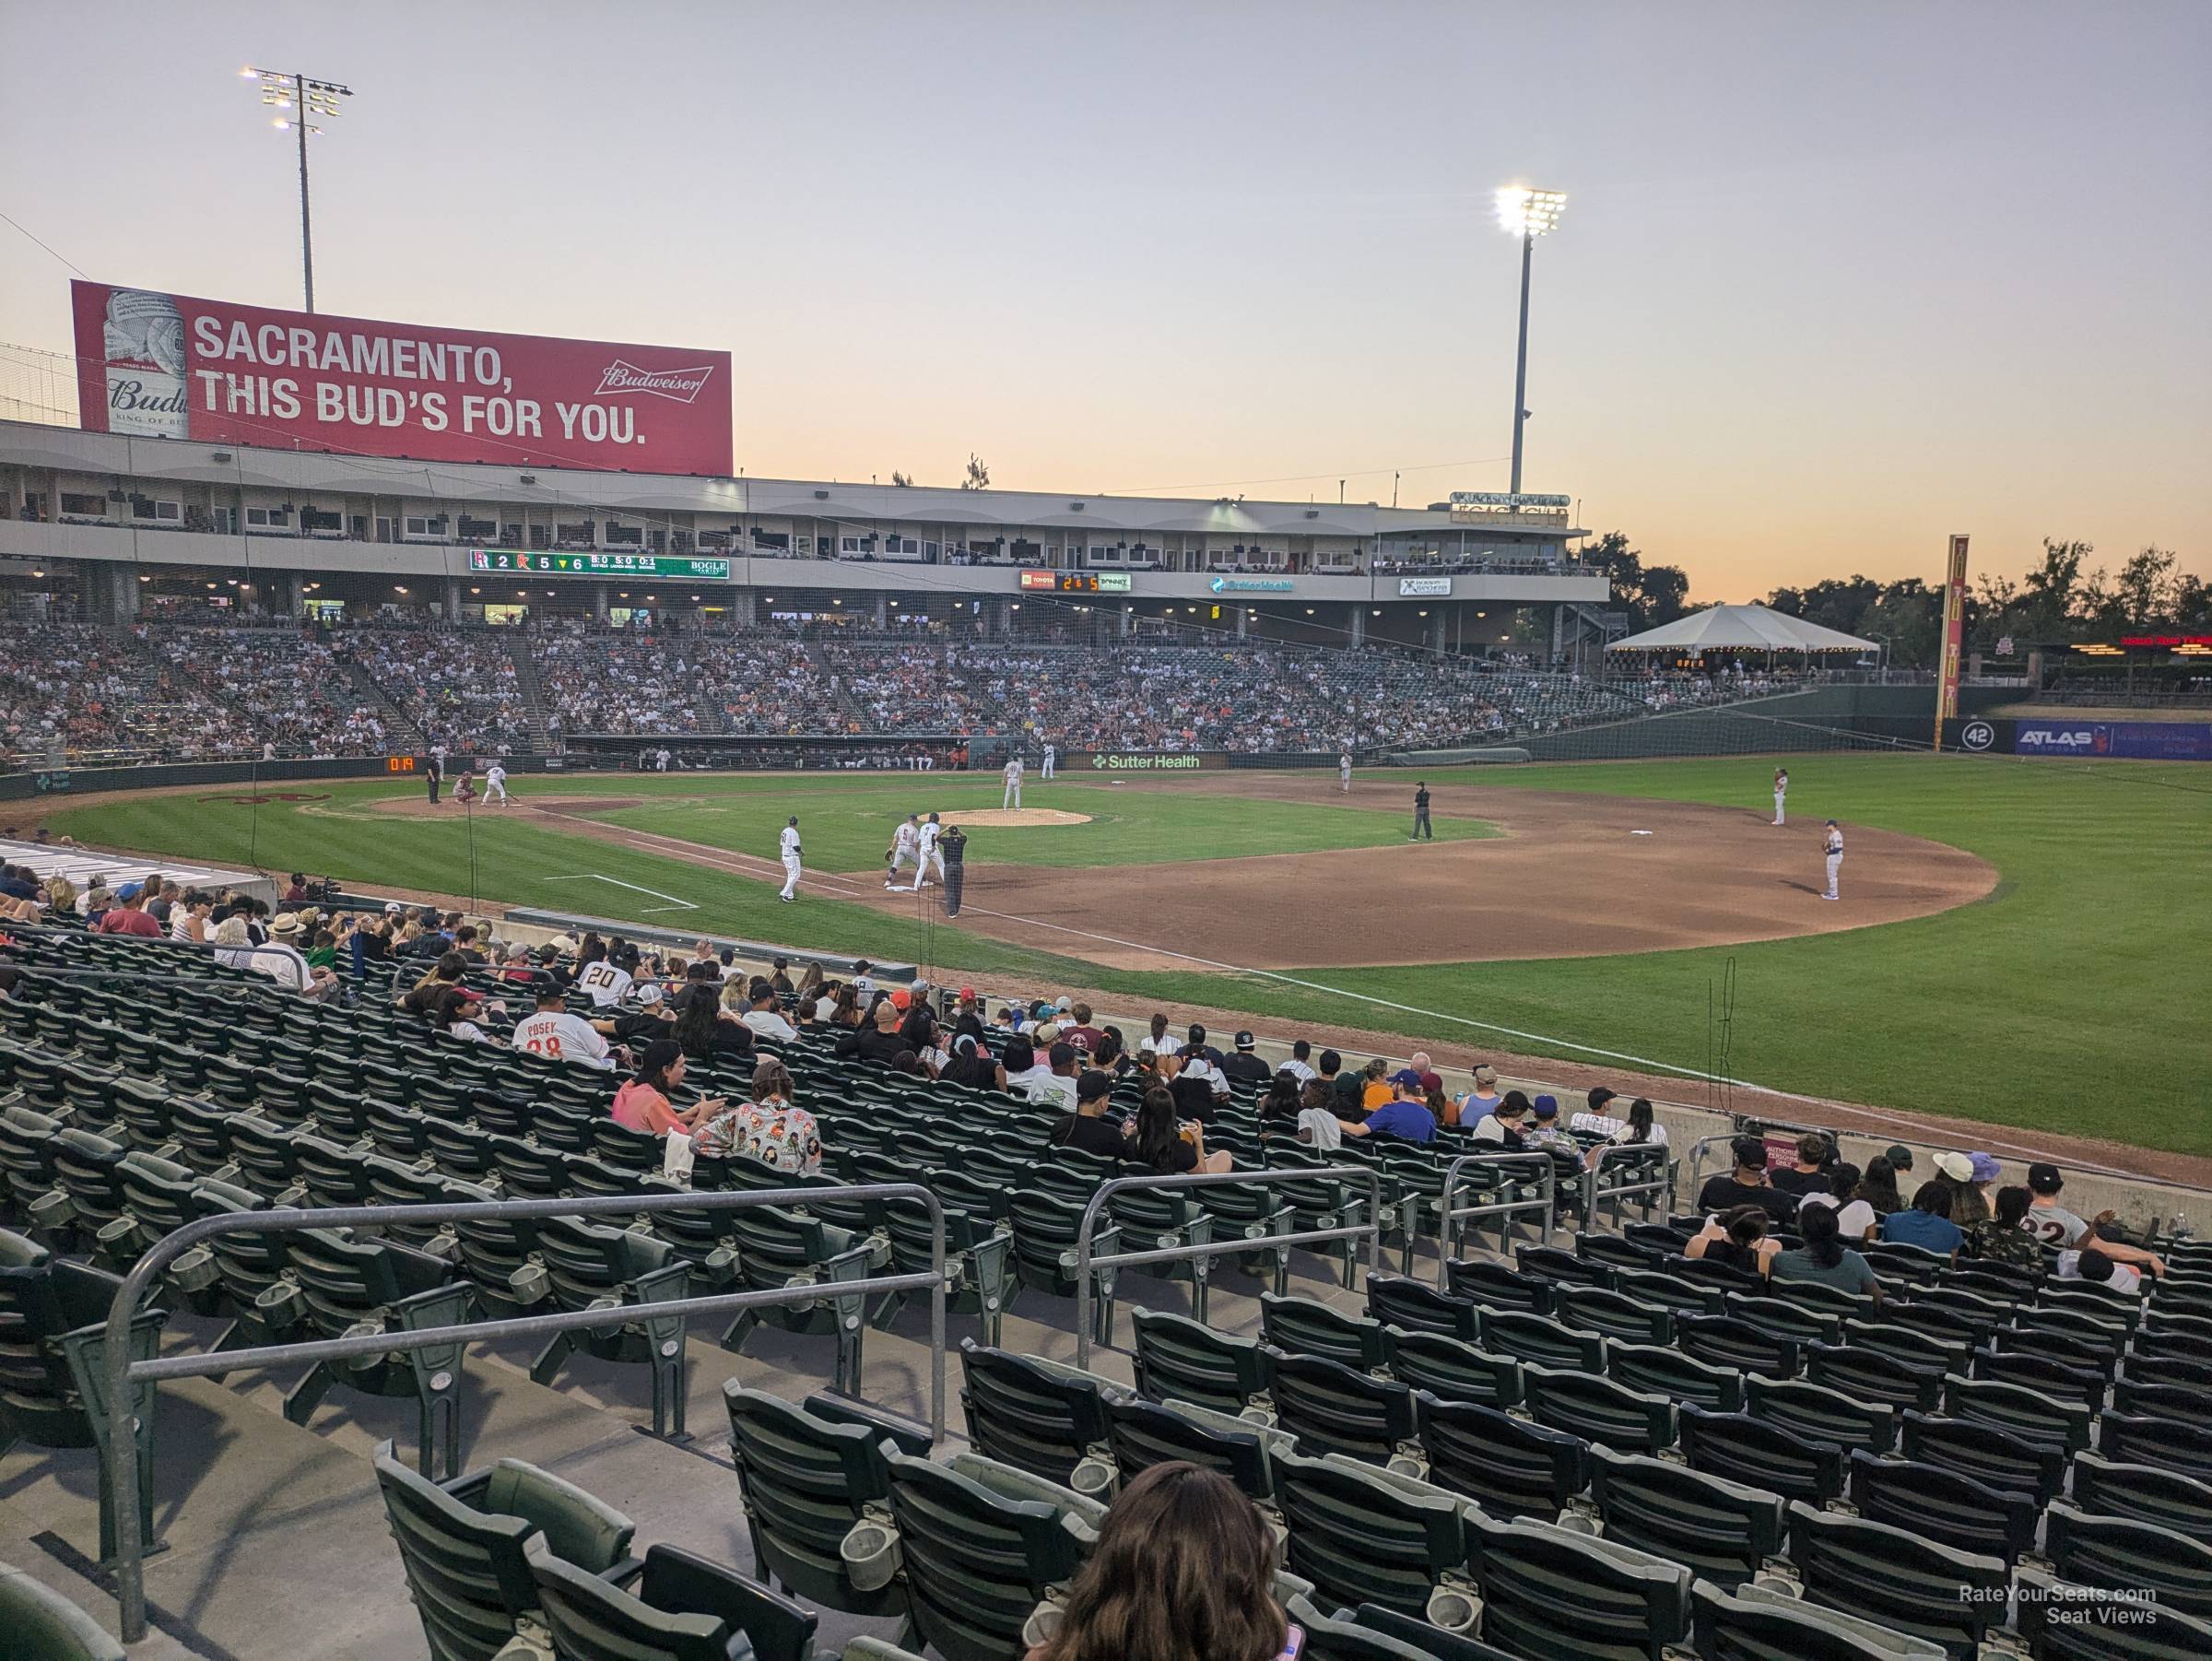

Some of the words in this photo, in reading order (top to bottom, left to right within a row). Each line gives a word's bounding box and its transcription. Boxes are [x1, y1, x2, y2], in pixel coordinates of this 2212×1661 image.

[194, 316, 512, 394] SACRAMENTO,
[603, 367, 701, 391] Budweiser
[195, 370, 300, 418] THIS
[316, 382, 449, 431] BUD'S
[463, 395, 543, 438] FOR
[555, 403, 645, 443] YOU.
[499, 556, 508, 567] 2
[540, 558, 549, 568] 5
[573, 559, 582, 569] 6
[691, 560, 726, 571] BOGLE
[1064, 577, 1072, 590] 2
[1076, 579, 1082, 588] 6
[1090, 577, 1099, 590] 5
[1967, 728, 1988, 743] 42
[2019, 730, 2092, 746] ATLAS
[1108, 755, 1152, 769] Sutter
[1155, 754, 1200, 769] Health
[586, 966, 617, 989] 20
[527, 1021, 558, 1037] POSEY
[1766, 1146, 1799, 1157] AUTHORIZ
[1768, 1152, 1800, 1163] PERSONN
[1775, 1159, 1792, 1167] ONLY
